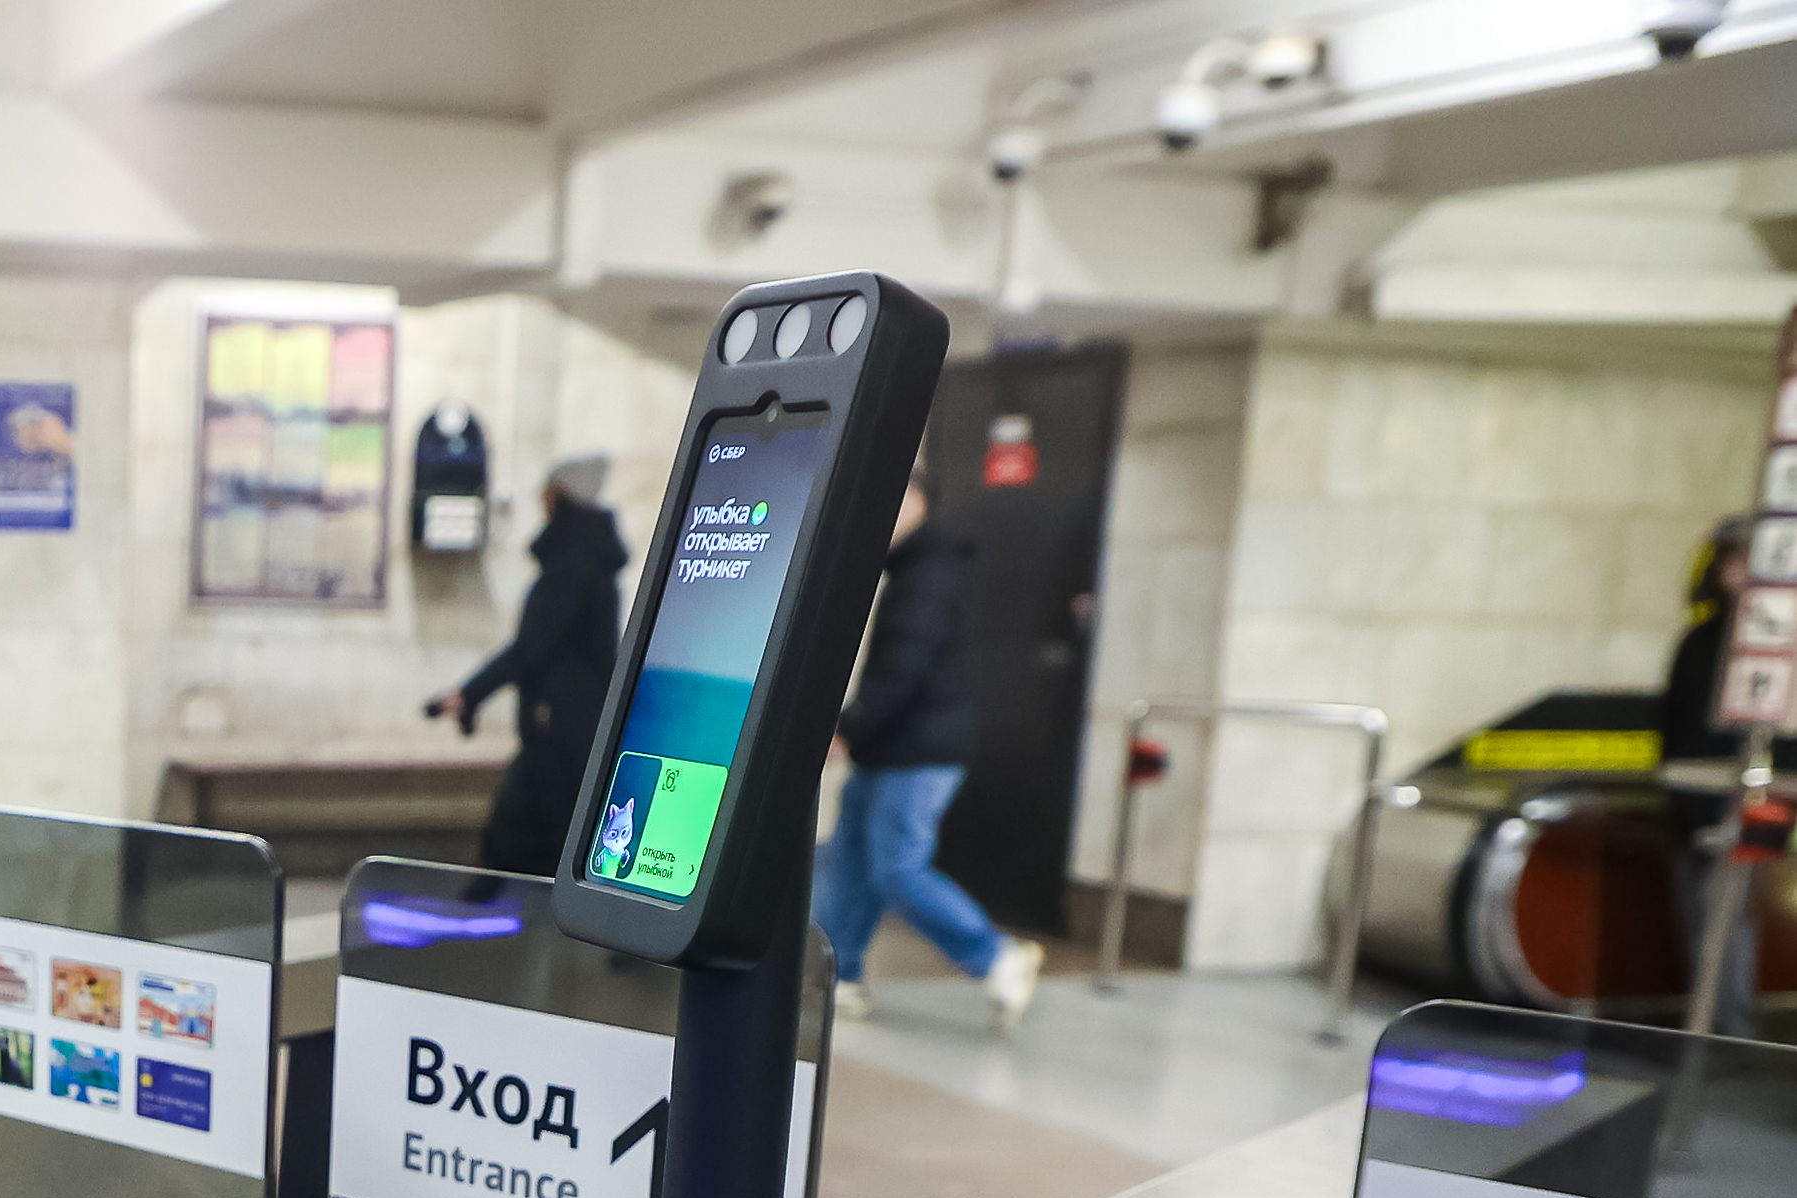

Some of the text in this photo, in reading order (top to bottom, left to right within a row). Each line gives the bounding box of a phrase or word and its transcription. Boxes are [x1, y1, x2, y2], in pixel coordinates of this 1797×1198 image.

[720, 446, 747, 460] СБЕР
[689, 497, 752, 531] улыбка
[683, 532, 771, 557] открывает
[677, 558, 752, 584] турникет
[642, 847, 676, 862] открыть
[636, 863, 673, 879] улыбкой
[406, 1035, 579, 1150] Вход
